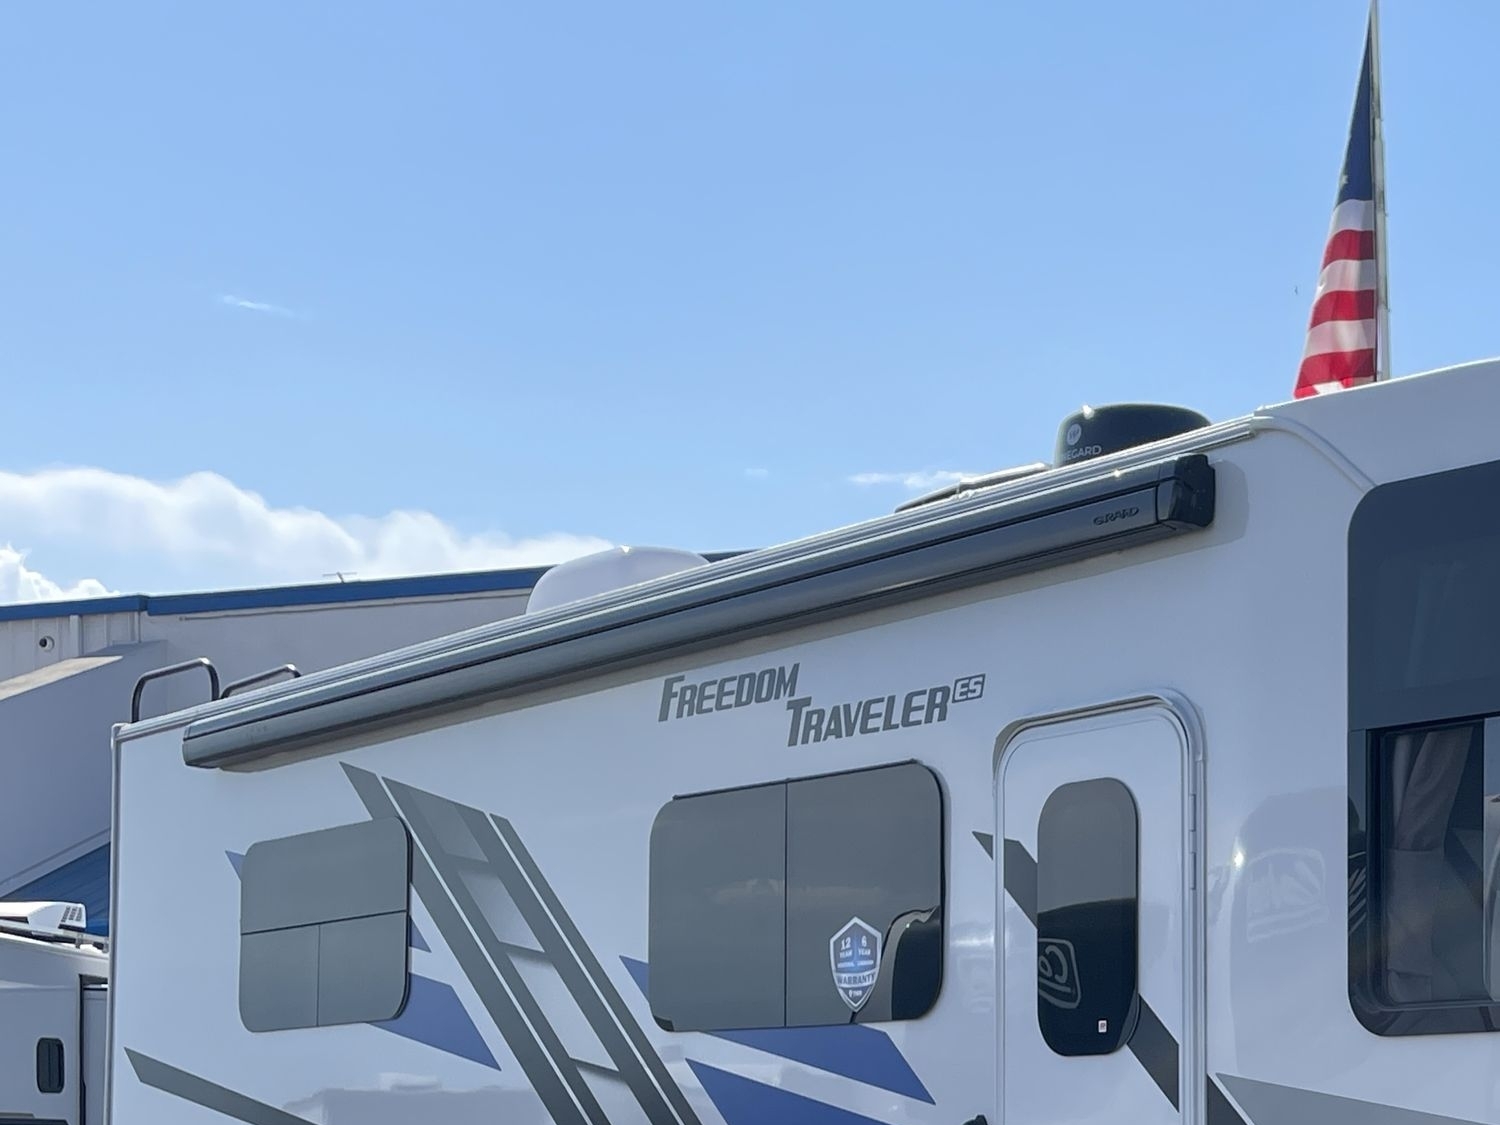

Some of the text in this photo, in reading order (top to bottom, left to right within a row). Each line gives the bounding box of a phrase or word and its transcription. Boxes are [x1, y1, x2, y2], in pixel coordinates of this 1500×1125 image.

[658, 663, 800, 722] FREEDOM
[785, 675, 985, 747] TRAVELER ES
[840, 937, 851, 951] 12
[837, 972, 876, 985] WARRANTY
